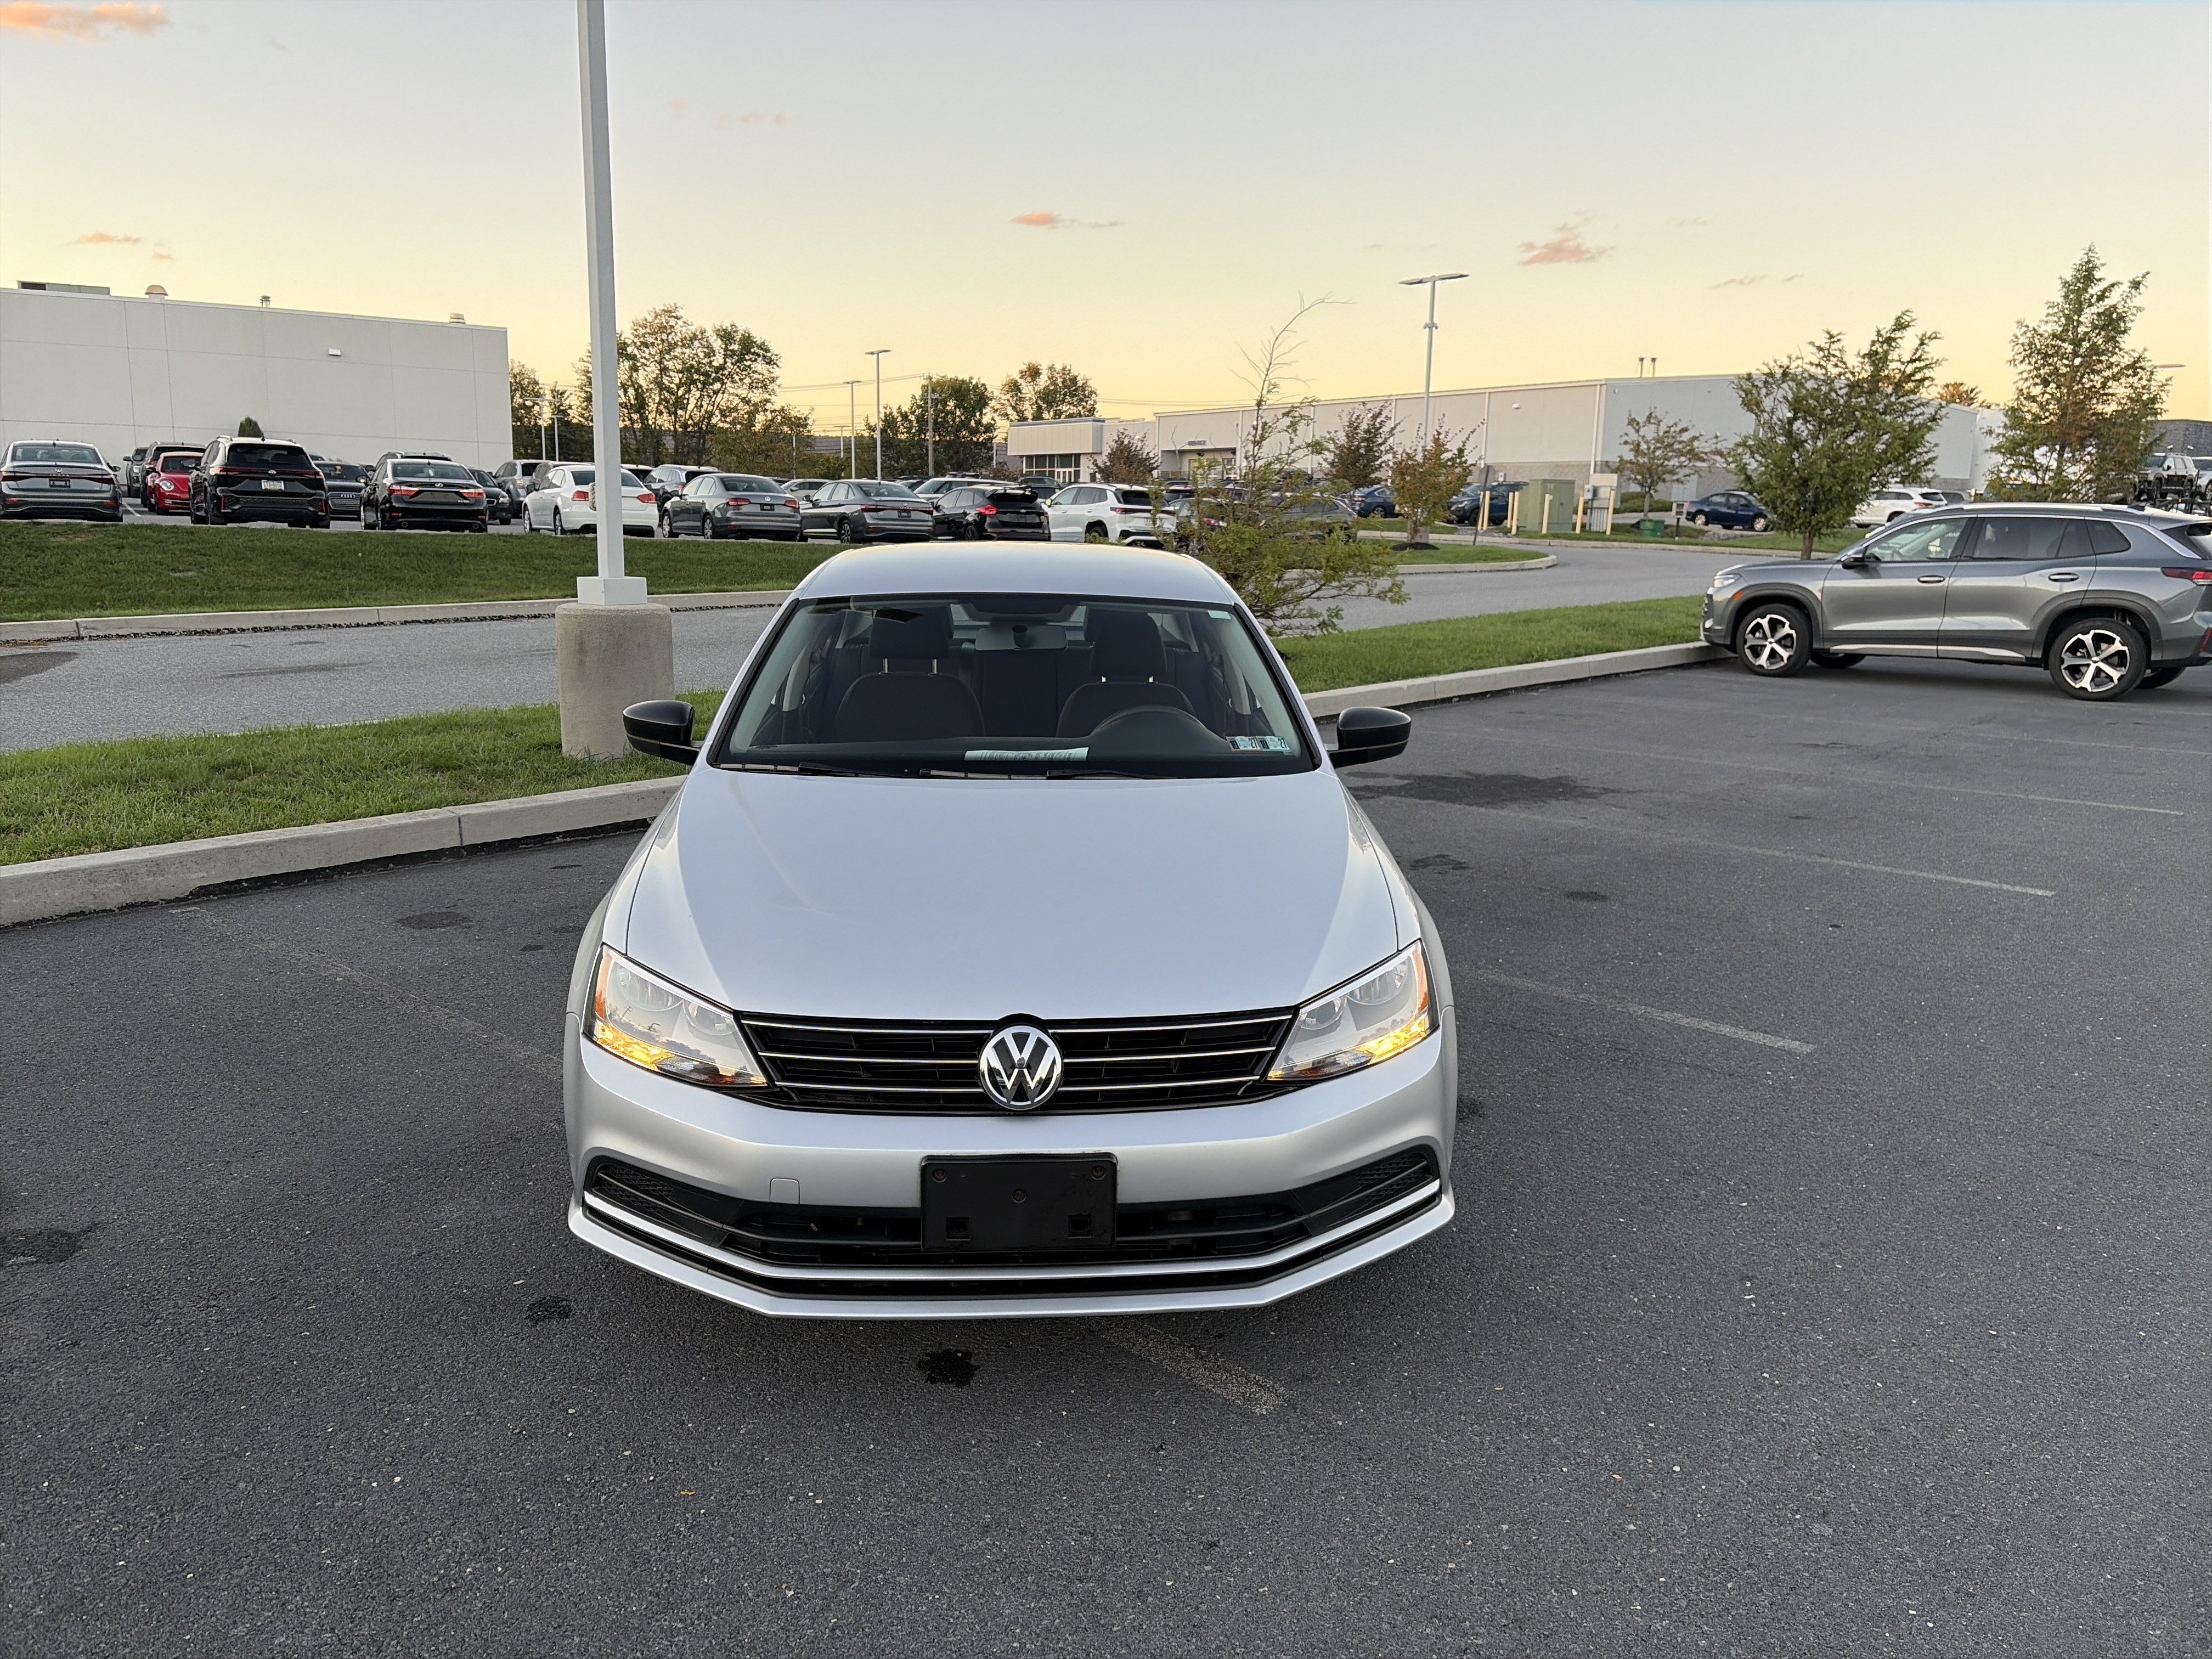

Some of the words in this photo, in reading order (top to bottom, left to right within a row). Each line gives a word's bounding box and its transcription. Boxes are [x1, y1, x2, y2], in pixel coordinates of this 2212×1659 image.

[1229, 740, 1240, 749] 10
[1248, 738, 1258, 749] 27
[1259, 740, 1270, 749] 10
[1278, 738, 1287, 749] 27
[981, 1025, 1060, 1108] VW
